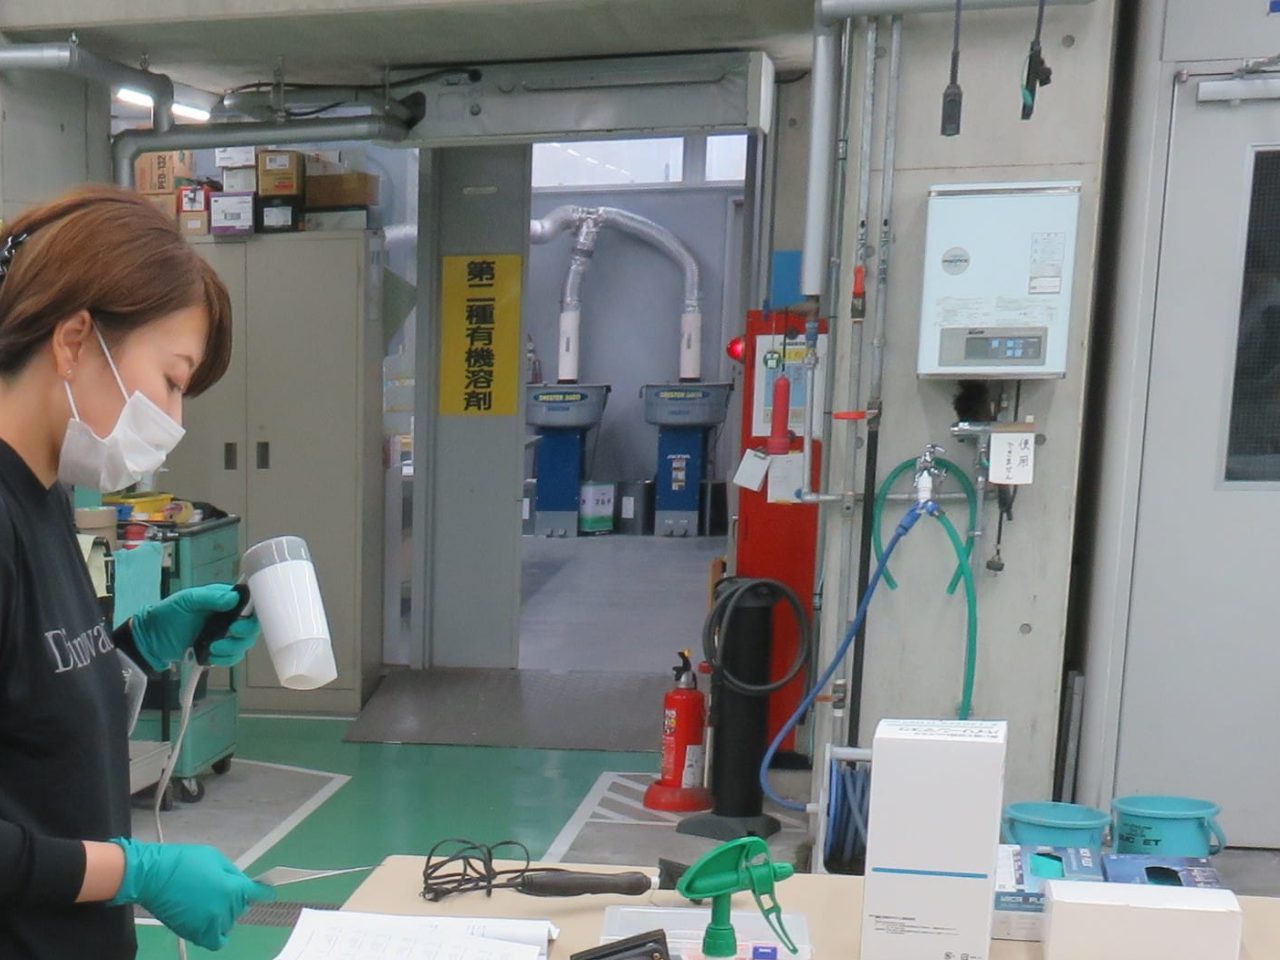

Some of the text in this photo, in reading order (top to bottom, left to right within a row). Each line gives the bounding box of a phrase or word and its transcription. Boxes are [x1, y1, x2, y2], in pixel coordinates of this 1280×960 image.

[463, 260, 496, 412] 第二種有機溶剤
